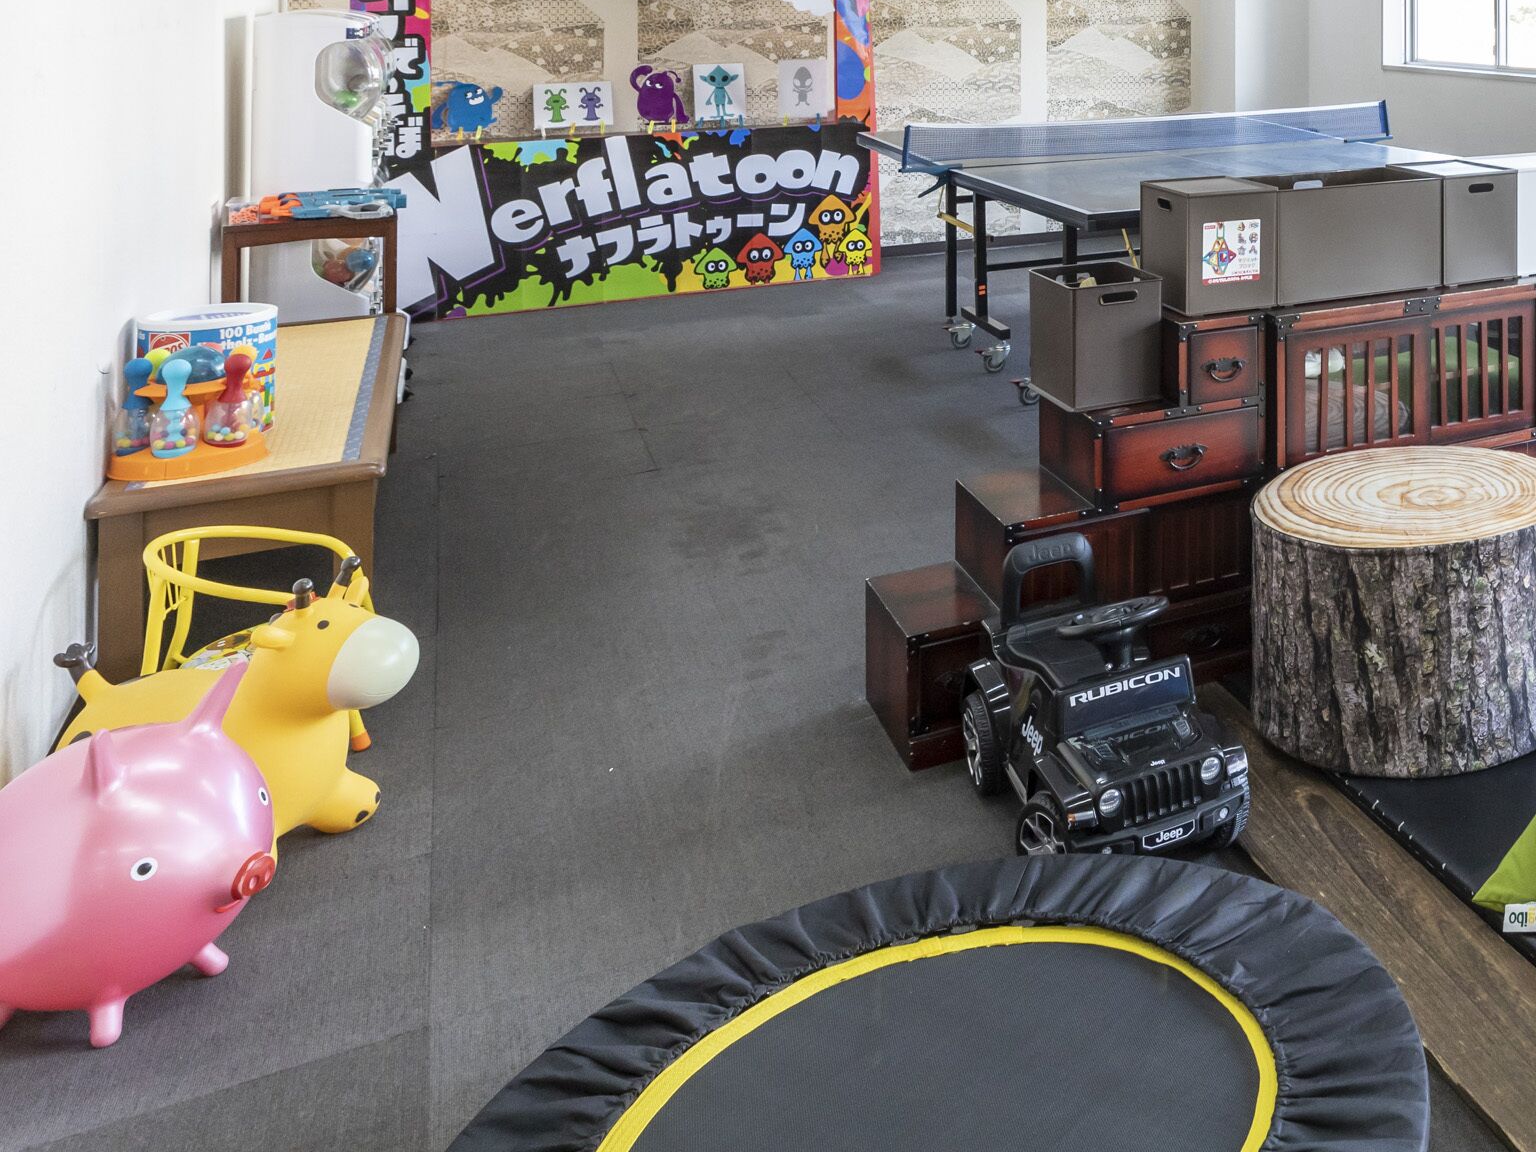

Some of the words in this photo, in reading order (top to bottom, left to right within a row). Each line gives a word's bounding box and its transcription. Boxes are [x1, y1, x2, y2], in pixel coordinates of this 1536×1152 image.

[388, 136, 860, 312] Nerflatoon
[555, 203, 806, 278] ナフラトゥーン
[219, 326, 243, 339] 100
[1027, 543, 1071, 562] Jeep
[1069, 666, 1181, 707] RUBICON
[1021, 715, 1044, 757] Jeep
[1150, 759, 1166, 767] Jeep
[1155, 827, 1183, 843] Jeep
